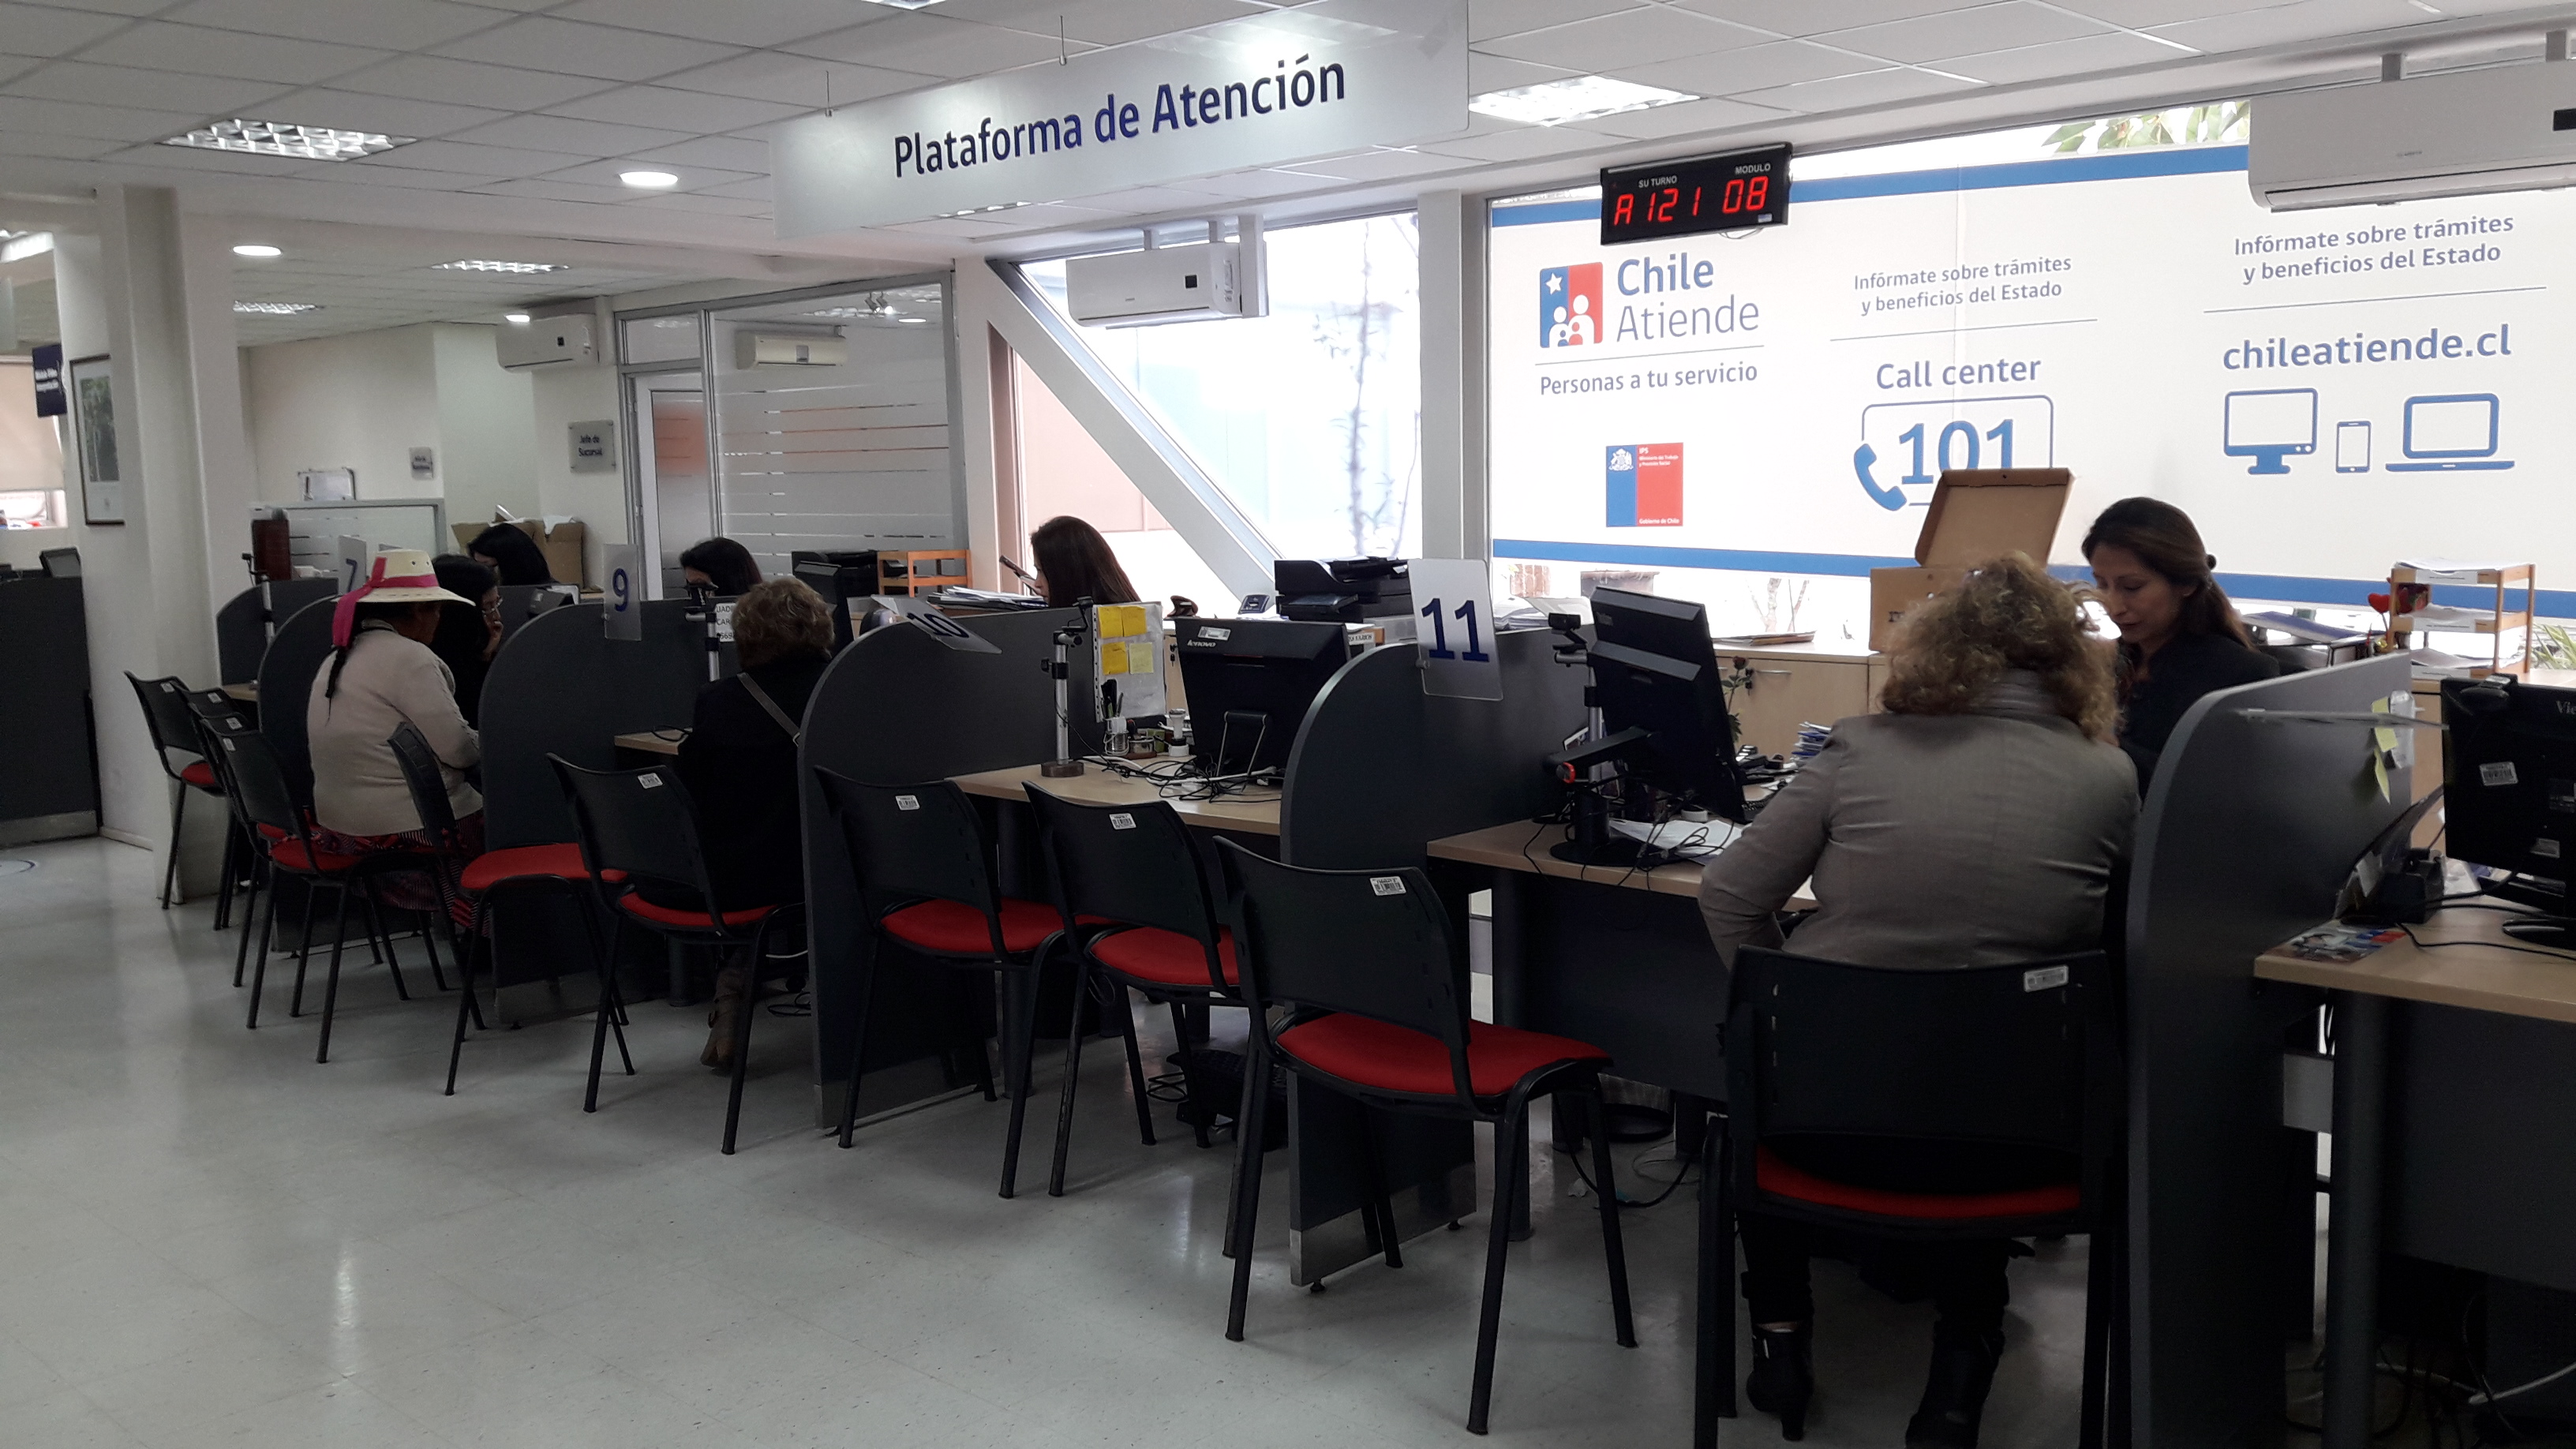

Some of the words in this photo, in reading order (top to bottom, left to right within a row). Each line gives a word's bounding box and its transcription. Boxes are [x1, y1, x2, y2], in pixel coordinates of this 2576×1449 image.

[894, 114, 1082, 178] Plataforma
[1095, 92, 1140, 143] de
[1152, 53, 1345, 133] Atención
[1638, 179, 1649, 188] SU
[1651, 175, 1677, 186] TURNO
[1735, 163, 1771, 174] MODULO
[1722, 175, 1769, 214] 08
[2234, 232, 2338, 255] Infórmate
[2346, 225, 2406, 246] sobre
[2413, 215, 2514, 239] trámites
[1617, 252, 1714, 296] Chile
[1855, 270, 1937, 290] Infórmate
[1941, 264, 1989, 282] sobre
[1994, 256, 2072, 276] trámites
[2243, 267, 2255, 285] y
[2262, 254, 2373, 279] beneficios
[2380, 249, 2415, 271] del
[2423, 243, 2501, 266] Estado
[1860, 301, 1870, 316] y
[1876, 290, 1964, 312] beneficios
[1969, 286, 1996, 302] del
[2001, 280, 2062, 301] Estado
[1616, 294, 1759, 342] Atiende
[2223, 323, 2512, 370] chileatiende.cl
[1541, 375, 1624, 395] Personas
[1630, 374, 1641, 388] a
[1647, 370, 1668, 388] tu
[1675, 361, 1758, 386] servicio
[1877, 360, 1932, 390] Call
[1942, 358, 2041, 385] center
[1899, 418, 2013, 485] 101
[346, 558, 358, 592] 7
[612, 568, 628, 612] 9
[907, 612, 969, 638] 10
[1421, 597, 1489, 662] 11
